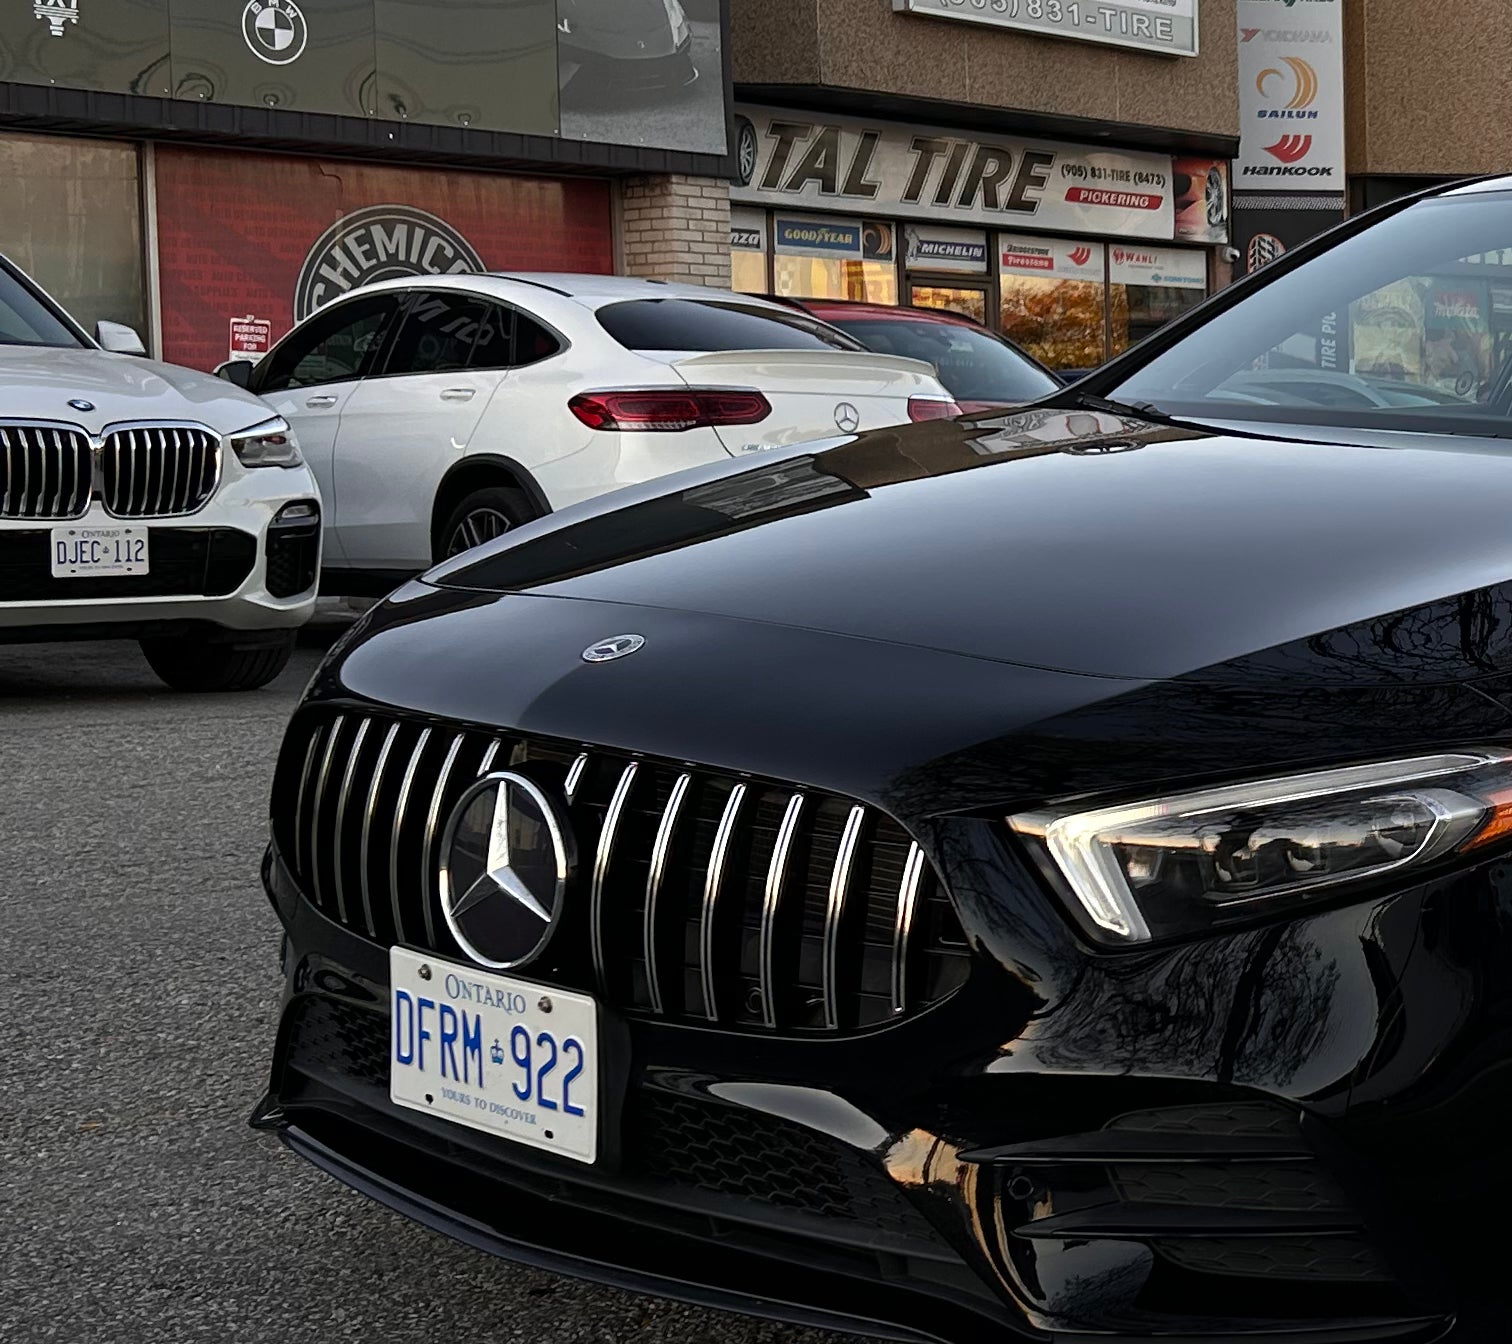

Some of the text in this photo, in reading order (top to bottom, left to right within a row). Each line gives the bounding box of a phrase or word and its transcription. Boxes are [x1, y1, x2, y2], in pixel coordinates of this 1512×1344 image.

[733, 115, 1057, 216] TAL TIRE
[1061, 164, 1166, 188] (905) 831-TIRE (8473)
[1079, 190, 1149, 207] PICKERING
[784, 228, 852, 244] GOODYEAR
[921, 242, 983, 258] MICHELIN
[312, 223, 467, 310] CHEMIC
[233, 324, 268, 334] RESERVED
[234, 333, 266, 343] PARKING
[243, 342, 257, 351] FOR
[1321, 338, 1337, 368] TIRE
[57, 539, 145, 565] DJEC 112
[445, 973, 527, 1015] ONTARIO
[396, 989, 585, 1117] DFRM 922
[441, 1087, 537, 1125] YOURS TO DISCOVER
